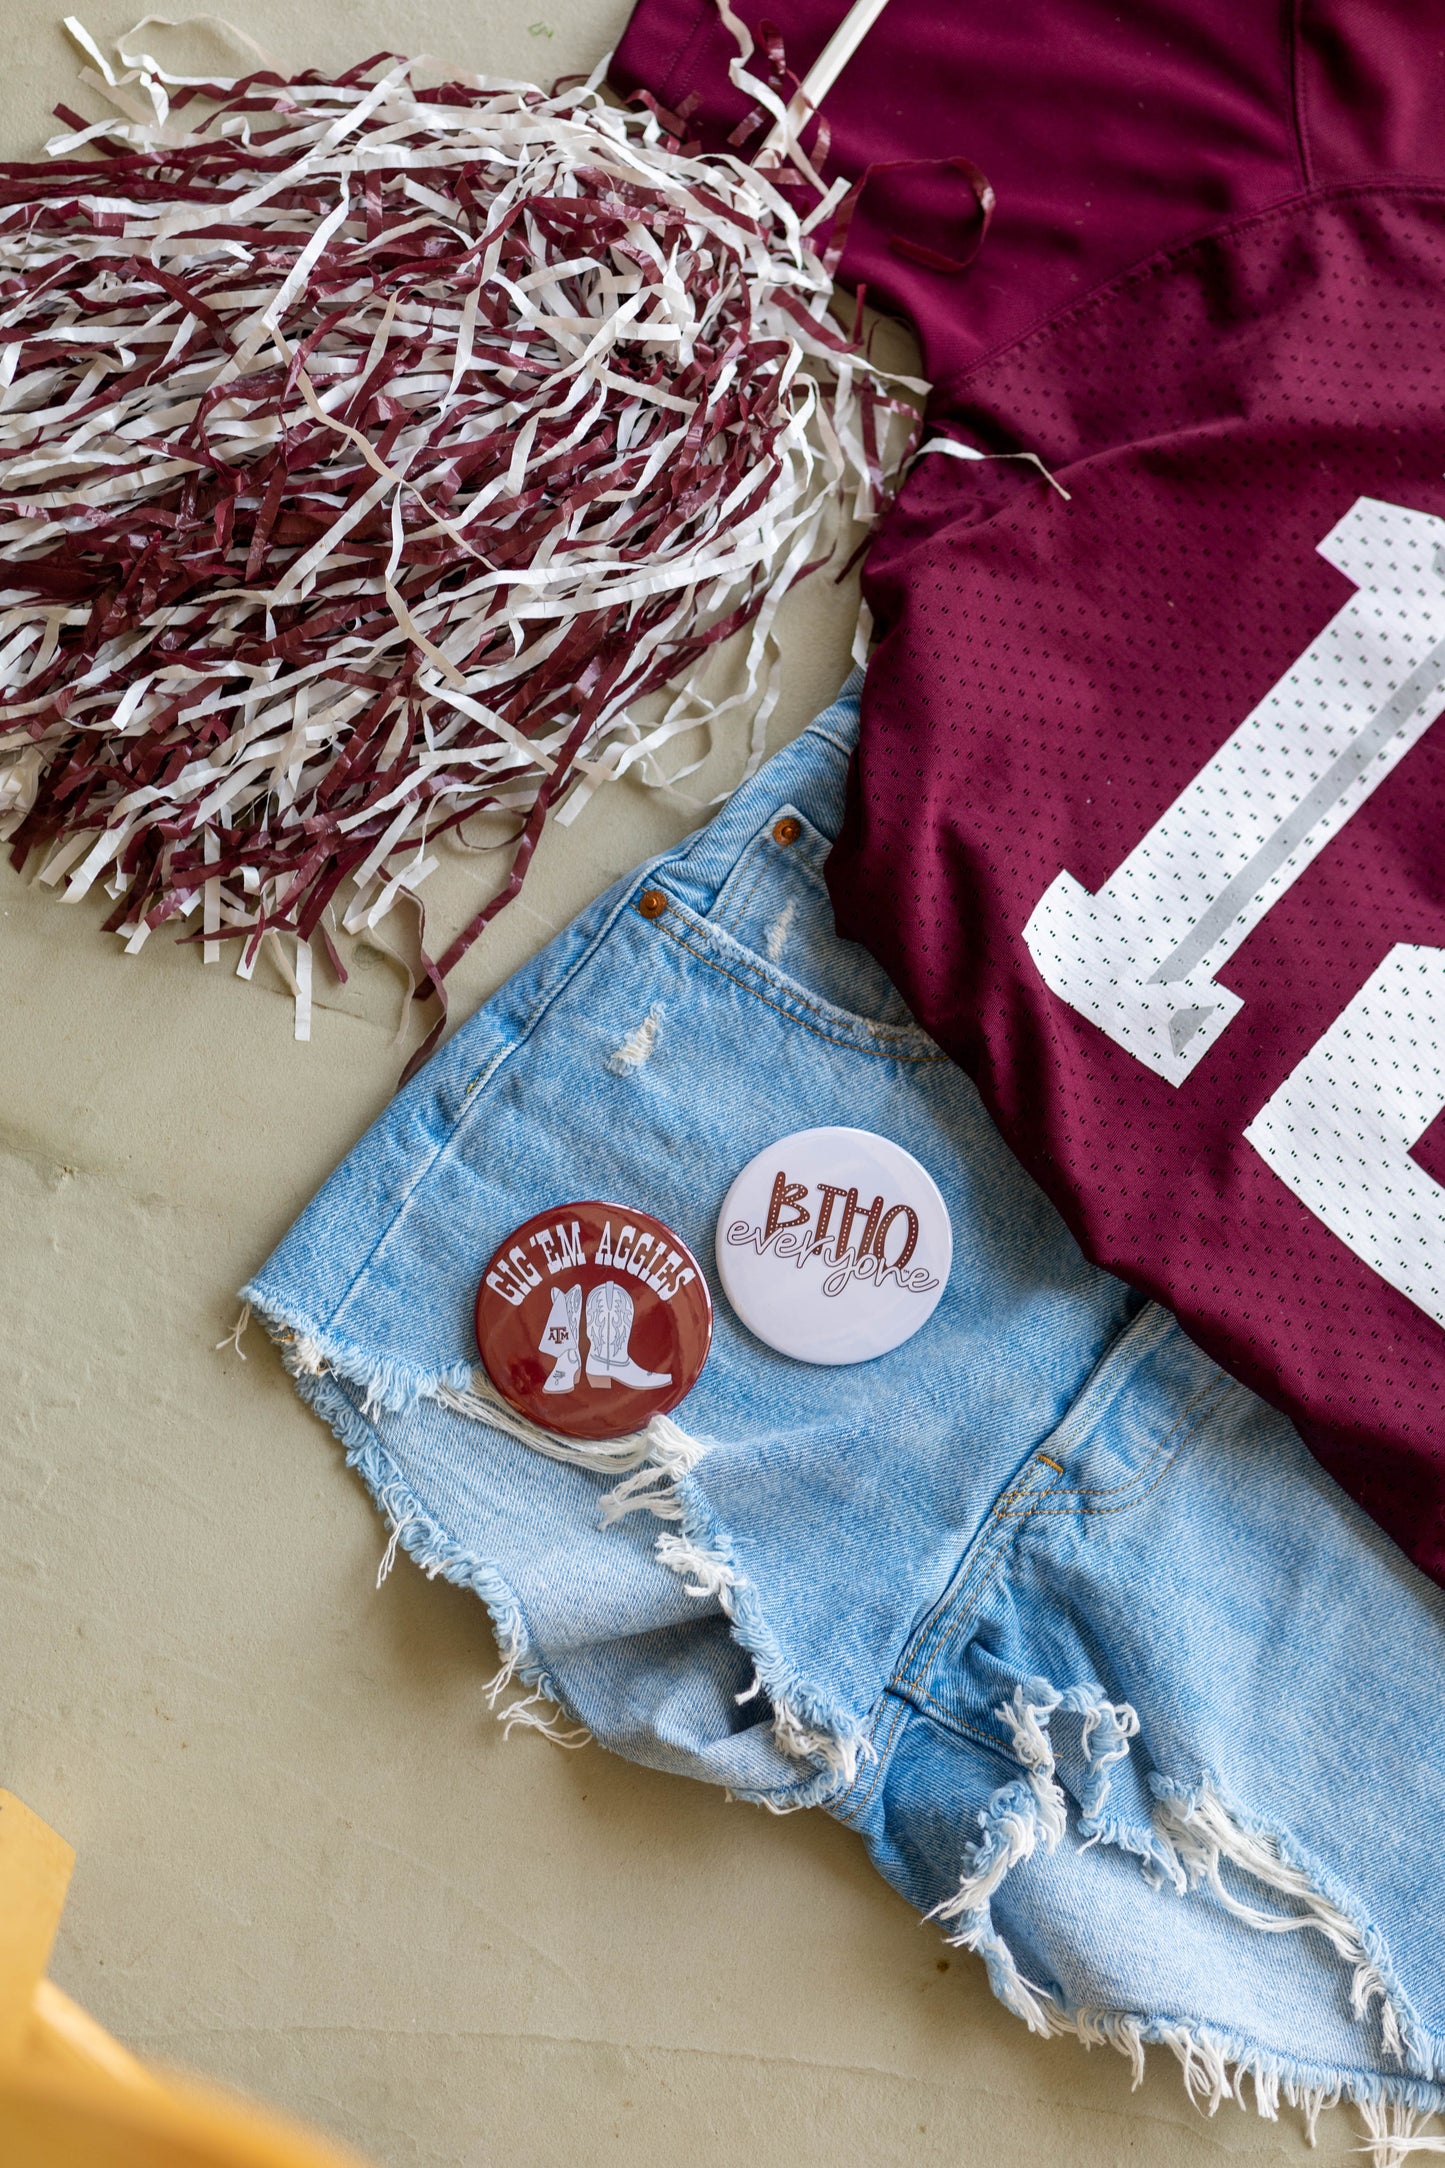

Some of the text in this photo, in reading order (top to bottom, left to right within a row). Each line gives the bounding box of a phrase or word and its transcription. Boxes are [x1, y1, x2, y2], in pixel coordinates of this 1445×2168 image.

[486, 1245, 543, 1306] GIG
[594, 1221, 696, 1301] AGGIES
[727, 1220, 939, 1297] everyone
[764, 1171, 919, 1271] BTHO
